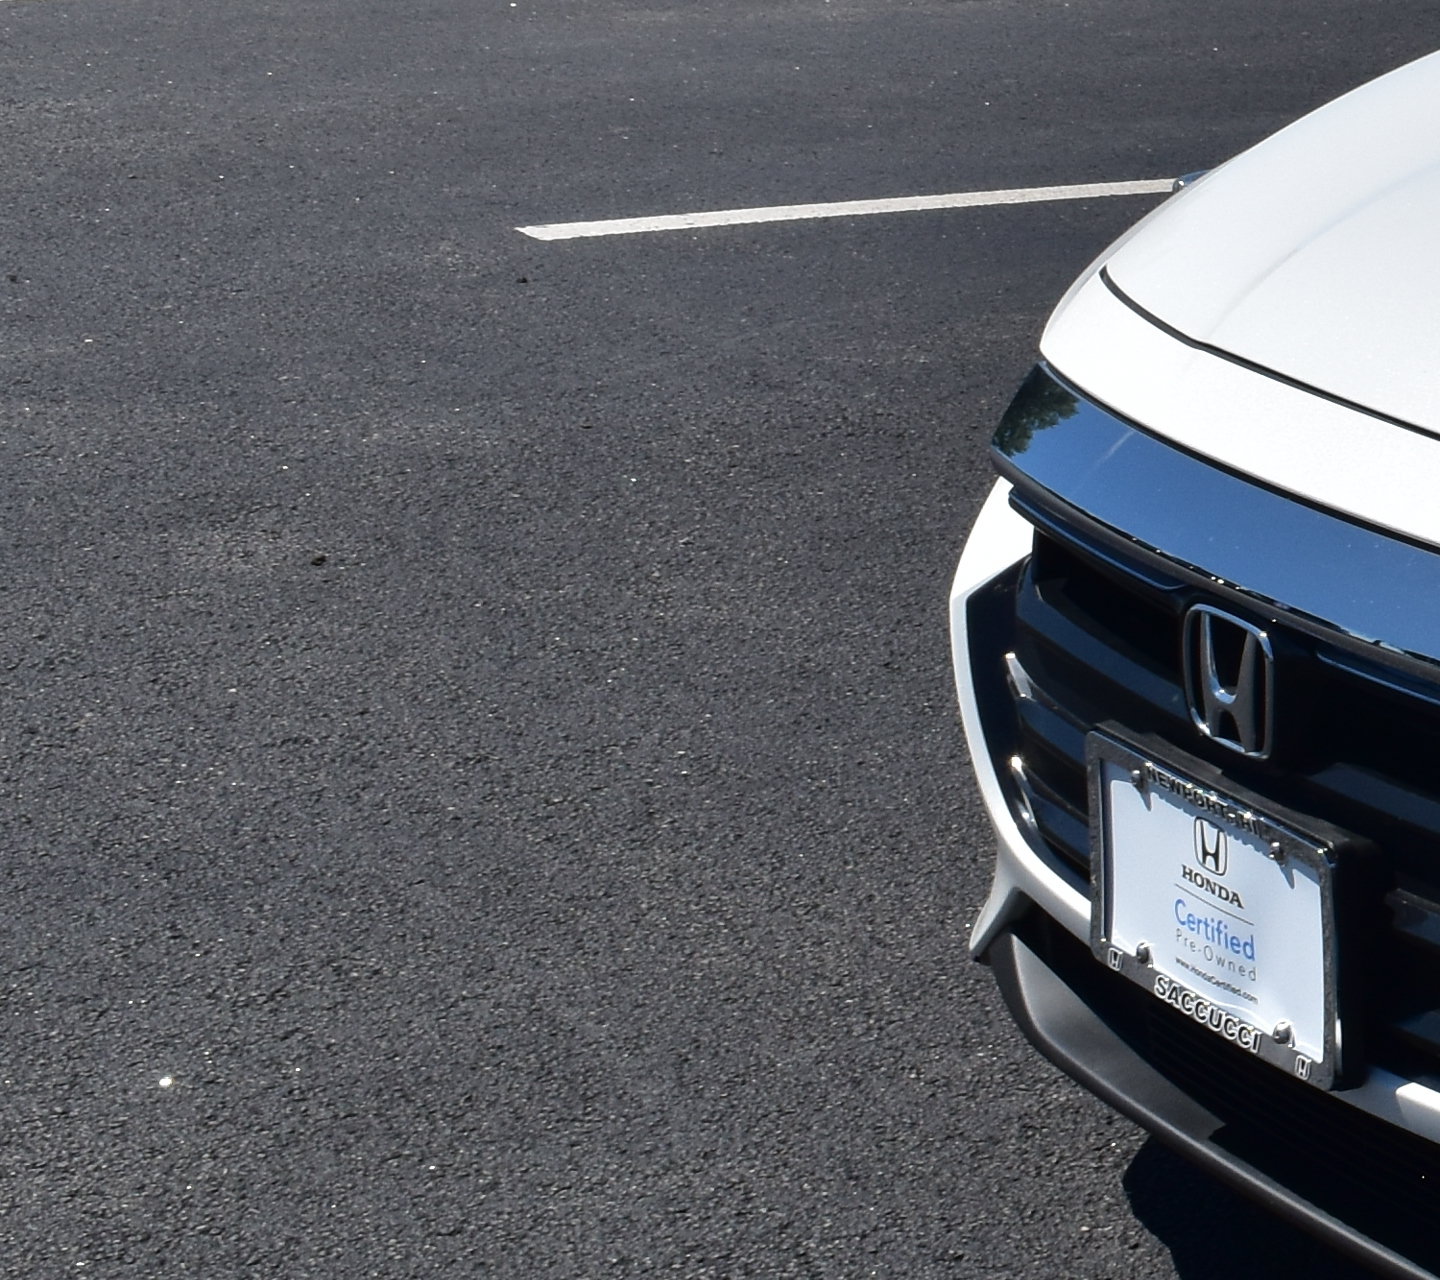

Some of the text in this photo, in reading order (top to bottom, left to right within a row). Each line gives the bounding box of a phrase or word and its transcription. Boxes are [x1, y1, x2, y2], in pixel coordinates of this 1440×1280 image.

[1181, 863, 1245, 910] HONDA
[1174, 898, 1256, 961] Certified
[1176, 927, 1257, 982] Pre-Owned
[1154, 974, 1263, 1054] SACCUCCI
